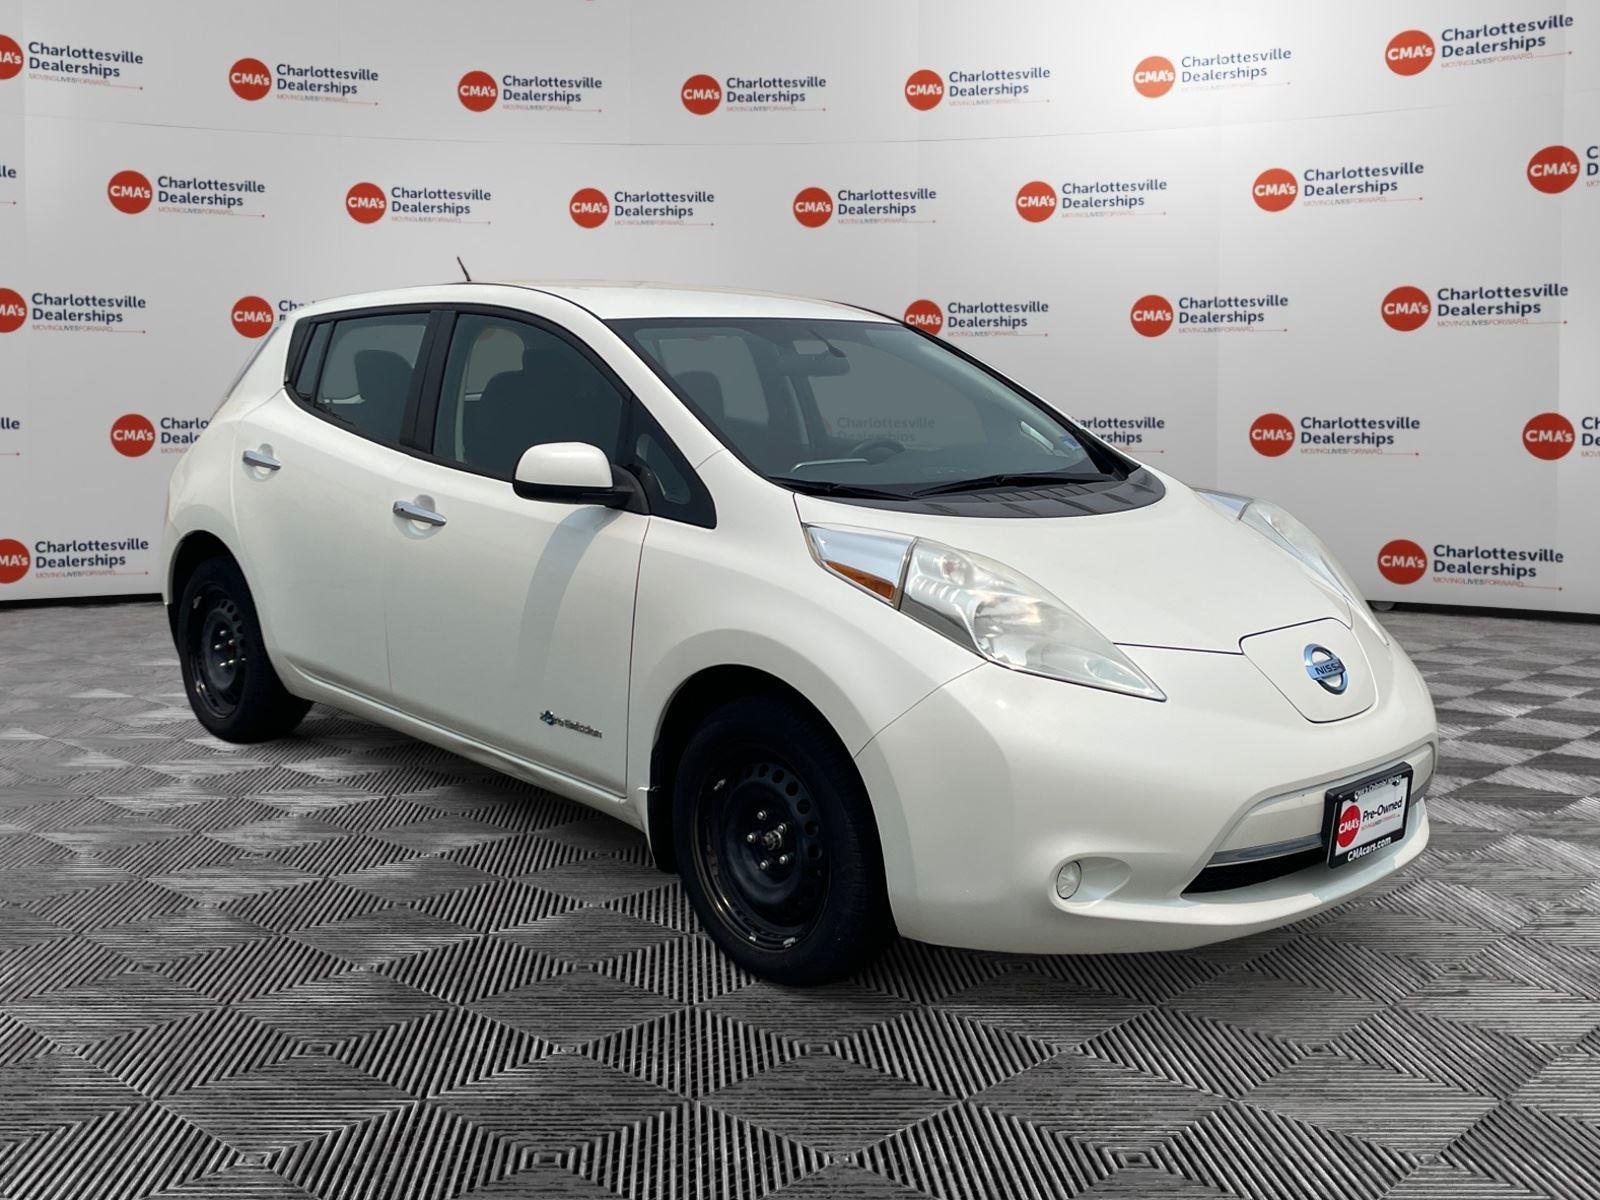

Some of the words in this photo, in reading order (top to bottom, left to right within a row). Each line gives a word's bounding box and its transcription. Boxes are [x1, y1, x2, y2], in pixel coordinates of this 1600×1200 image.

[1441, 14, 1574, 42] Charlottesville
[29, 41, 144, 65] Charlottesville
[1388, 45, 1434, 61] CMA's
[1441, 34, 1546, 58] Dealerships
[0, 52, 22, 66] A's
[1182, 48, 1293, 68] Charlottesville
[29, 57, 120, 79] Dealerships
[277, 63, 379, 82] Charlottesville
[949, 66, 1051, 83] Charlottesville
[1182, 66, 1268, 83] Dealerships
[231, 72, 270, 86] CMA's
[502, 75, 602, 89] Charlottesville
[726, 76, 827, 90] Charlottesville
[1135, 69, 1175, 84] CMA's
[277, 78, 358, 96] Dealerships
[459, 85, 497, 98] CMA's
[907, 83, 944, 95] CMA's
[949, 82, 1029, 97] Dealerships
[502, 88, 582, 104] Dealerships
[683, 89, 720, 101] CMA's
[726, 90, 806, 104] Dealerships
[1303, 162, 1424, 182] Charlottesville
[1530, 162, 1578, 177] CMA's
[110, 185, 151, 198] CMA's
[158, 176, 266, 193] Charlottesville
[1062, 179, 1167, 195] Charlottesville
[1255, 184, 1296, 198] CMA's
[1303, 179, 1398, 197] Dealerships
[158, 191, 244, 208] Dealerships
[391, 186, 492, 202] Charlottesville
[614, 191, 715, 204] Charlottesville
[838, 188, 937, 202] Charlottesville
[1018, 195, 1056, 208] CMA's
[348, 197, 385, 209] CMA's
[391, 200, 471, 217] Dealerships
[572, 202, 609, 214] CMA's
[795, 201, 832, 214] CMA's
[838, 202, 916, 217] Dealerships
[1062, 194, 1145, 210] Dealerships
[614, 205, 694, 219] Dealerships
[1437, 283, 1569, 301] Charlottesville
[32, 292, 146, 309] Charlottesville
[948, 301, 1049, 314] Charlottesville
[1179, 294, 1289, 309] Charlottesville
[32, 308, 123, 324] Dealerships
[234, 310, 272, 323] CMA's
[1133, 309, 1172, 321] CMA's
[1384, 302, 1429, 316] CMA's
[1437, 301, 1541, 318] Dealerships
[906, 313, 942, 326] CMA's
[948, 315, 1028, 330] Dealerships
[1179, 310, 1265, 326] Dealerships
[837, 417, 935, 429] Charlottesville
[1075, 417, 1165, 429] arlottesville
[1300, 416, 1421, 431] Charlottesville
[113, 429, 153, 442] CMA's
[1100, 431, 1142, 445] rships
[1252, 429, 1294, 441] CMA's
[1300, 431, 1394, 447] Dealerships
[1525, 429, 1573, 443] CMA's
[35, 538, 149, 554] Charlottesville
[0, 554, 29, 568] MA's
[35, 553, 126, 569] Dealerships
[1433, 544, 1564, 564] Charlottesville
[1381, 555, 1425, 569] CMA's
[1433, 560, 1537, 579] Dealerships
[1314, 659, 1343, 676] NISS
[1362, 796, 1403, 822] Pre-Owned
[1338, 818, 1360, 834] CMA's
[1347, 837, 1392, 862] CMAcars.com
